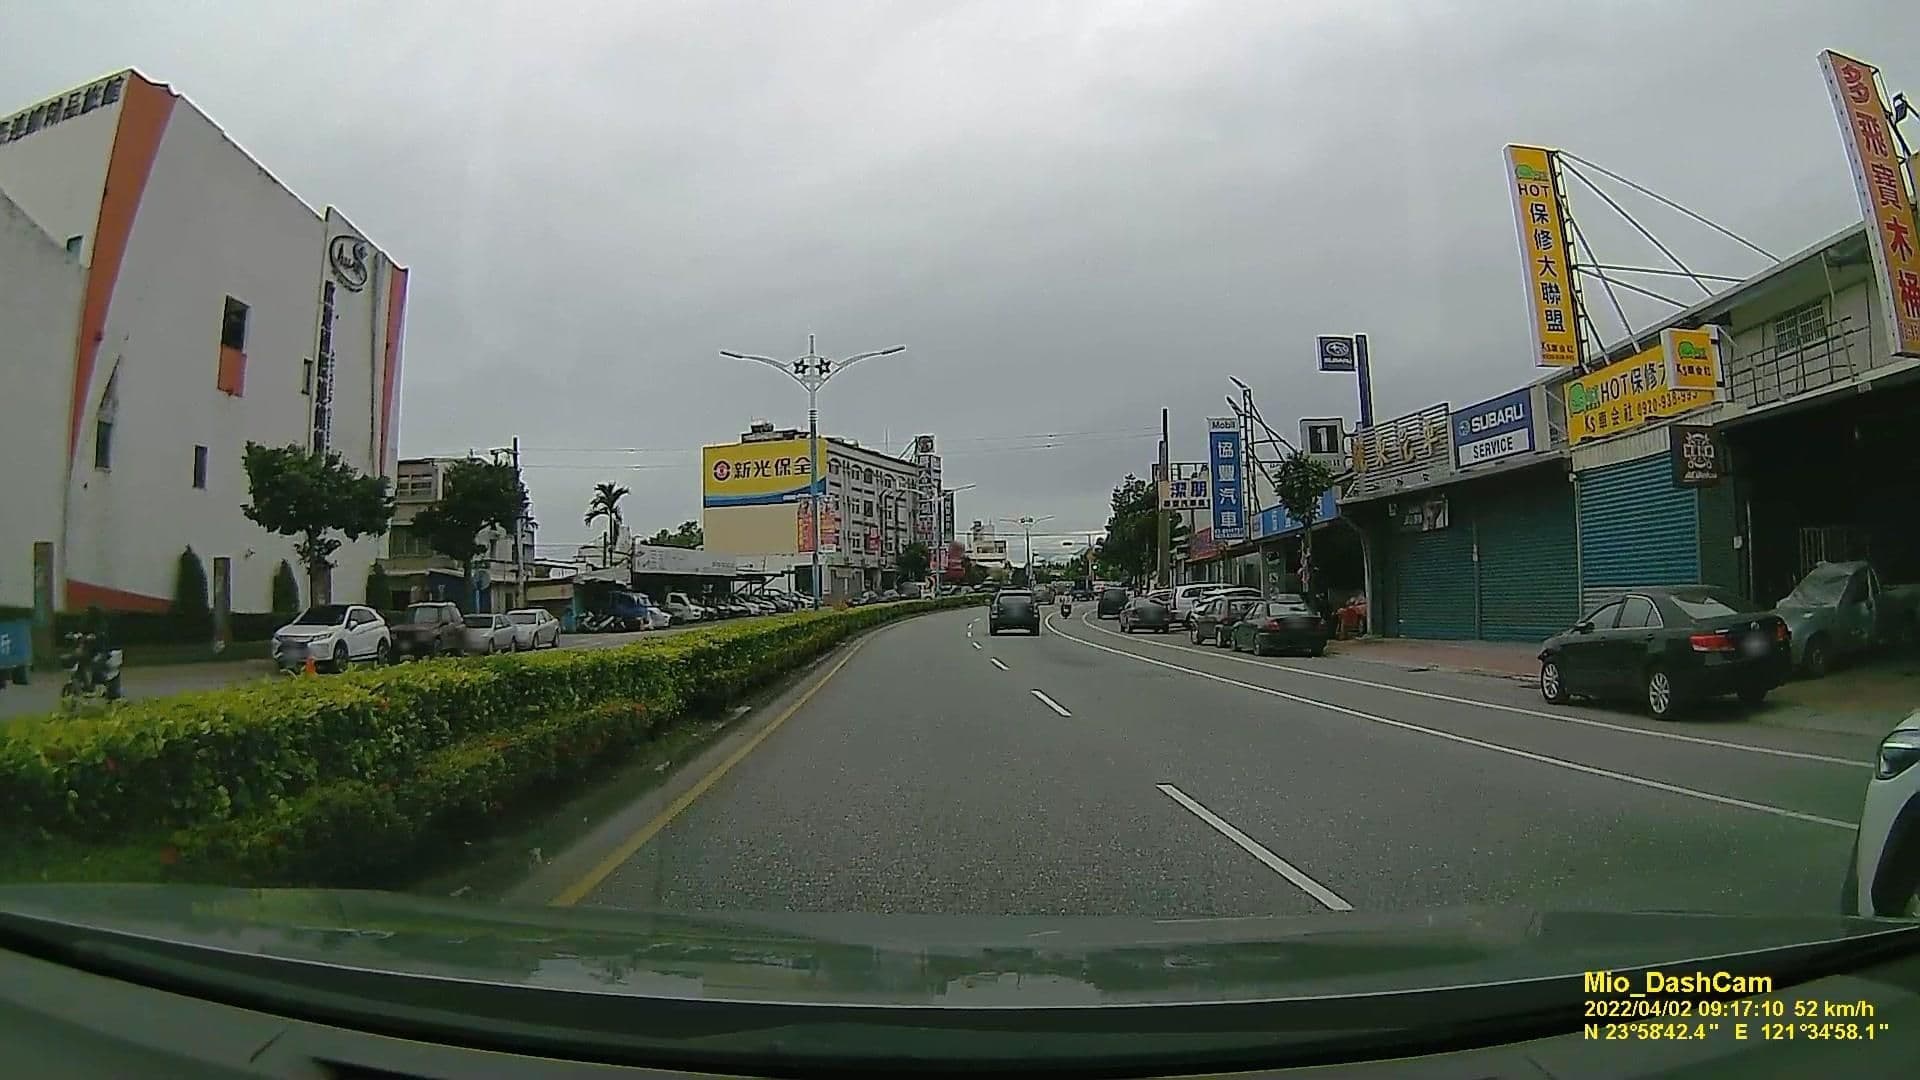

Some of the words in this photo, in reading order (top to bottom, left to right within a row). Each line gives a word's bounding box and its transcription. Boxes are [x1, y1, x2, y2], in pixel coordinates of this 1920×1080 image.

[1518, 183, 1550, 198] HOT
[1530, 202, 1566, 333] 保修大聯盟
[1212, 420, 1236, 429] Mobil
[1471, 402, 1524, 433] SUBARU
[1472, 435, 1514, 459] SERVICE
[733, 456, 812, 479] 新光保全
